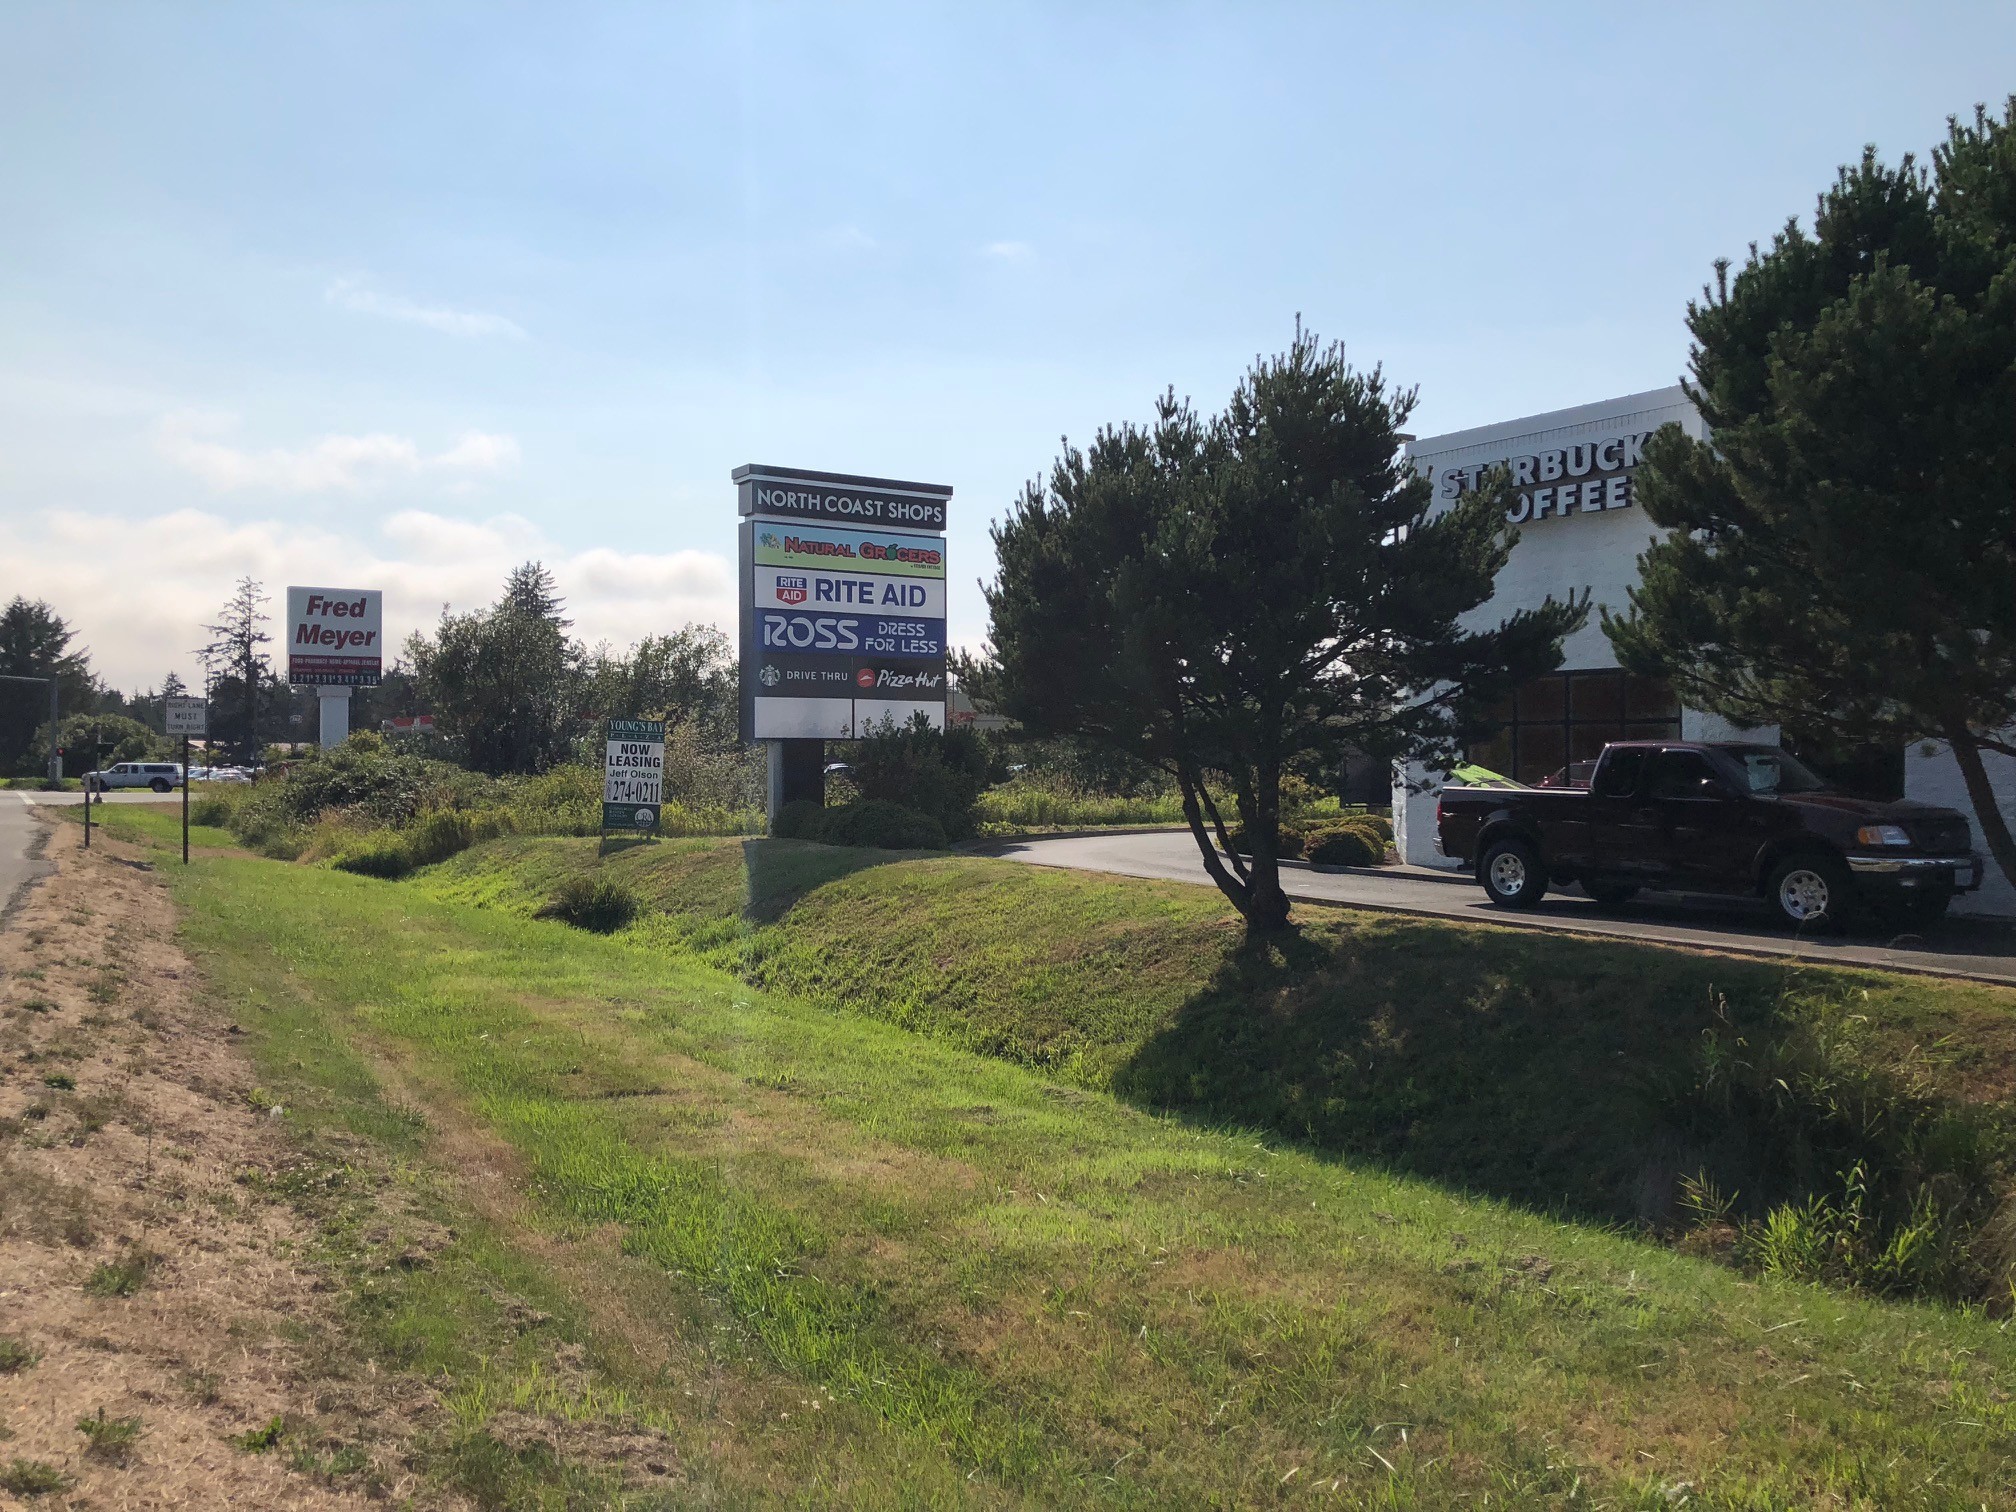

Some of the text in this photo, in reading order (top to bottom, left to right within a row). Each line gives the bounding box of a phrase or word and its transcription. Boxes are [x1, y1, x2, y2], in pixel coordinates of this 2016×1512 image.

[757, 488, 943, 523] NORTH COAST SHOPS
[784, 536, 857, 558] NATURAL
[780, 577, 804, 588] RITE
[781, 589, 802, 601] AID
[815, 578, 927, 608] RITE AID
[306, 595, 367, 618] Fred
[764, 615, 859, 650] ROSS
[878, 621, 926, 637] DRESS
[295, 623, 377, 651] Meyer
[865, 638, 938, 653] FOR LESS
[786, 671, 848, 682] DRIVE THRU
[876, 669, 942, 688] Pizza Hut
[174, 712, 196, 720] MUST
[610, 720, 664, 733] YOUNG'S BAY
[621, 744, 651, 755] NOW
[609, 756, 661, 768] LEASING
[609, 769, 658, 779] Jeff Olson
[612, 780, 659, 803] 274-0211
